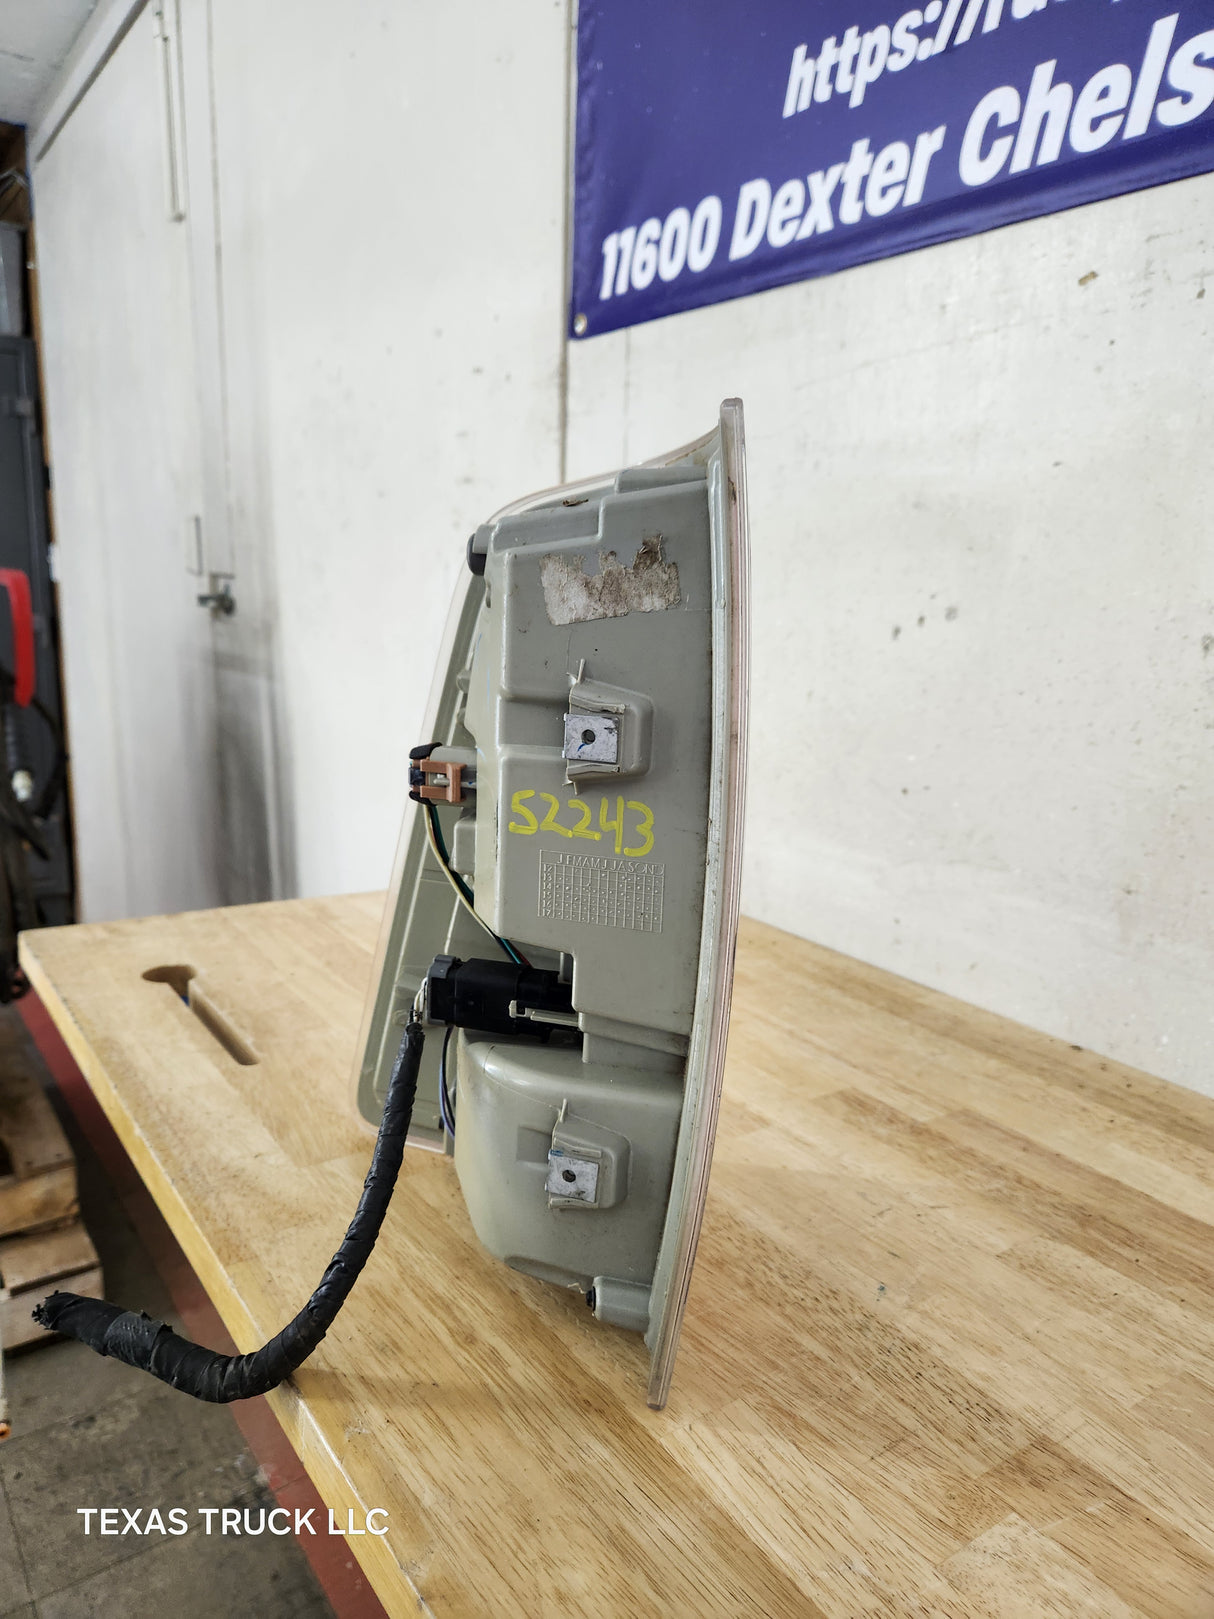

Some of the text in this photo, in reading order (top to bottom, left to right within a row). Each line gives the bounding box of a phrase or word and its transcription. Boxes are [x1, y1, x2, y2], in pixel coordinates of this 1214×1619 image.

[600, 195, 722, 300] 11600
[729, 125, 946, 261] Dexter
[508, 789, 655, 857] 52243
